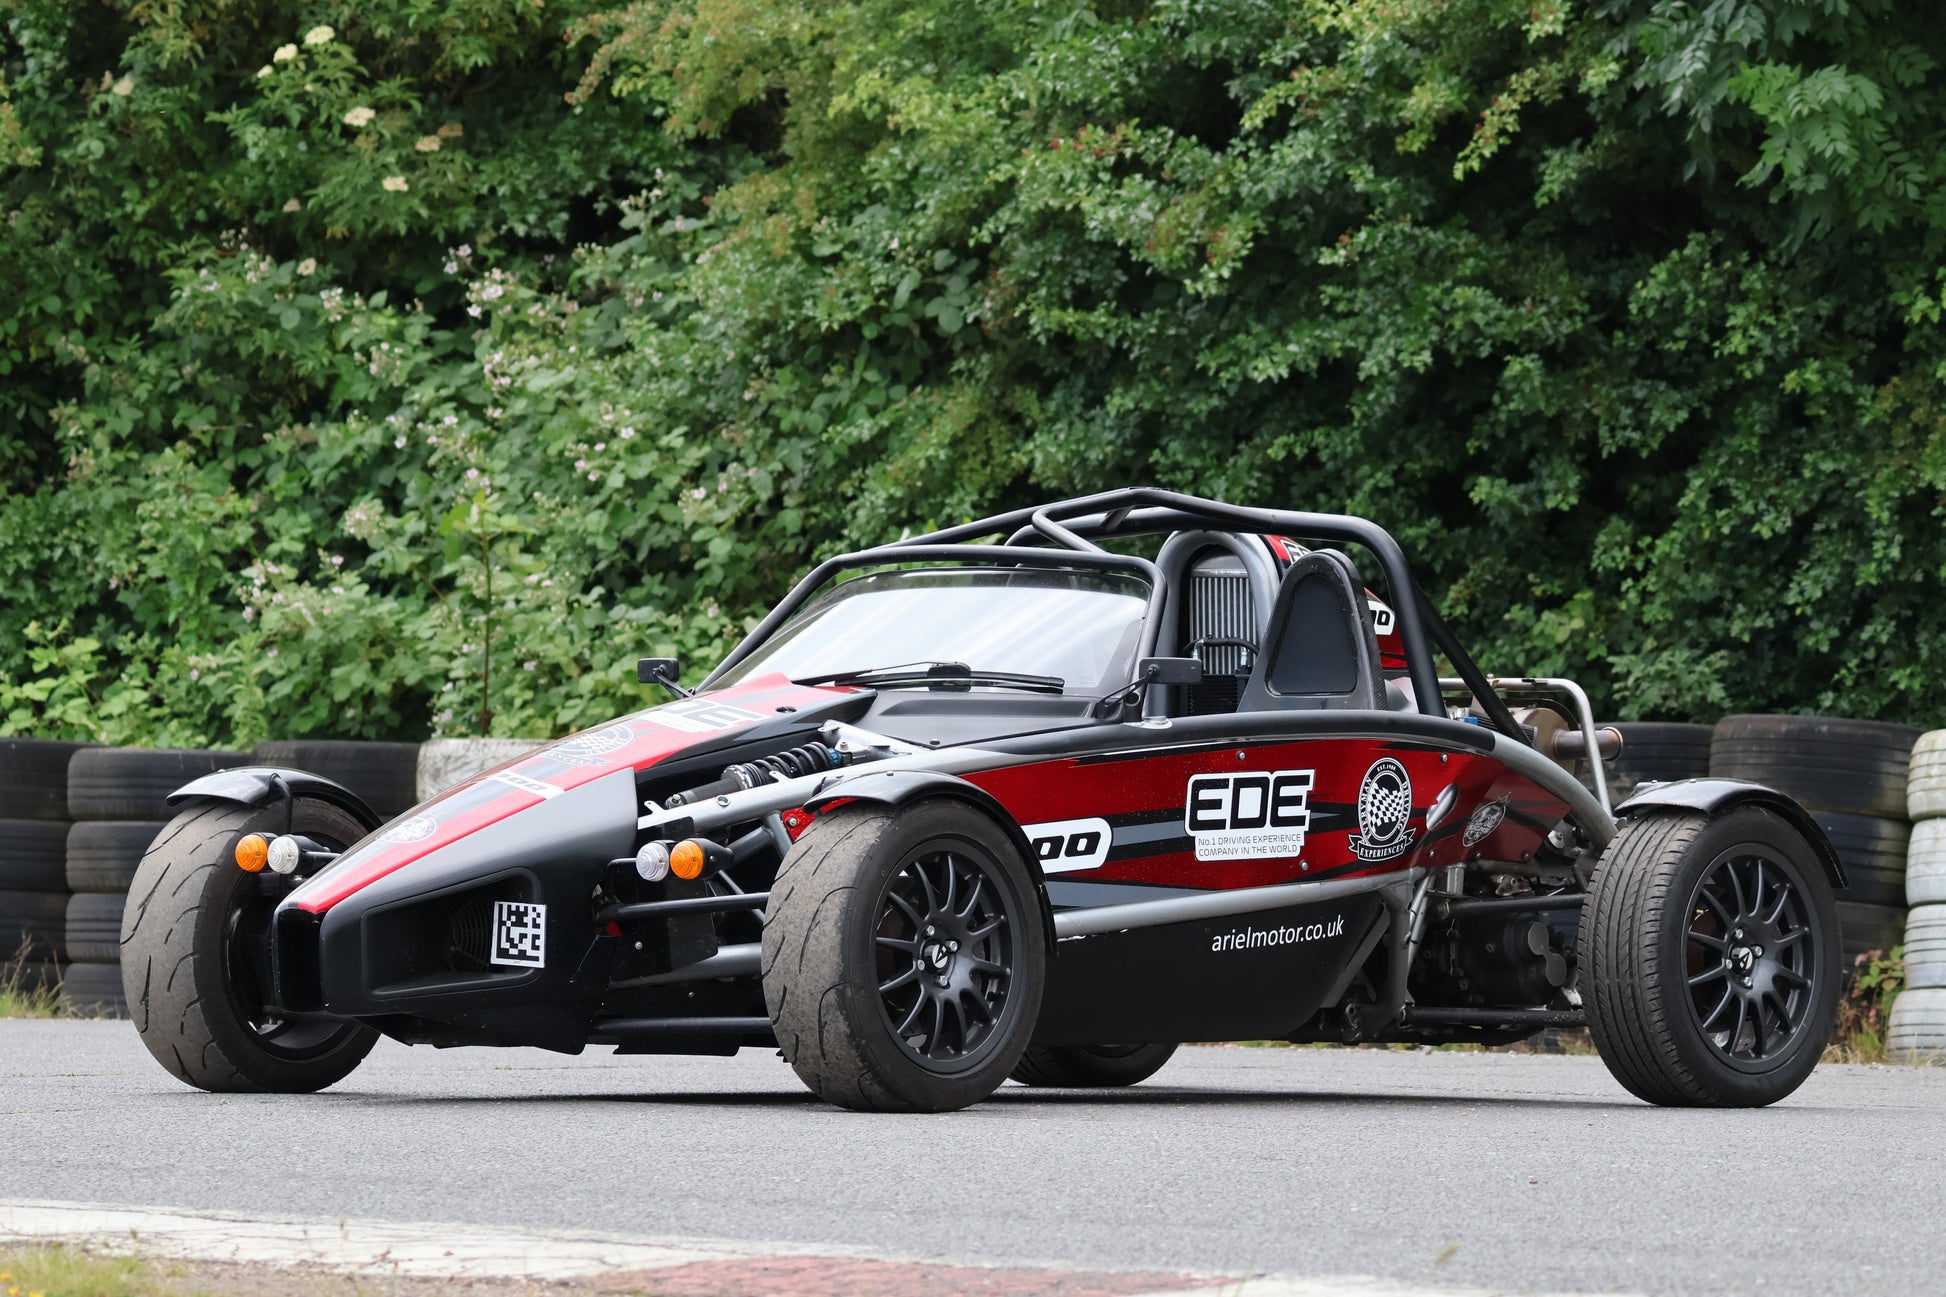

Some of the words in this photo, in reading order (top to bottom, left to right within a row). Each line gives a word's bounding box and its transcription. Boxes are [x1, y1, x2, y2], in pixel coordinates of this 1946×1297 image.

[1189, 775, 1310, 831] EDE
[1397, 781, 1410, 831] DRIVING
[1198, 847, 1239, 857] COMPANY
[1241, 846, 1250, 855] IN
[1251, 845, 1267, 855] THE
[1269, 844, 1298, 854] WORLD
[1218, 835, 1251, 846] DRIVING
[1252, 833, 1301, 844] EXPERIENCE
[1360, 843, 1405, 858] EXPERIENCES
[1211, 914, 1345, 952] arielmotor.co.uk
